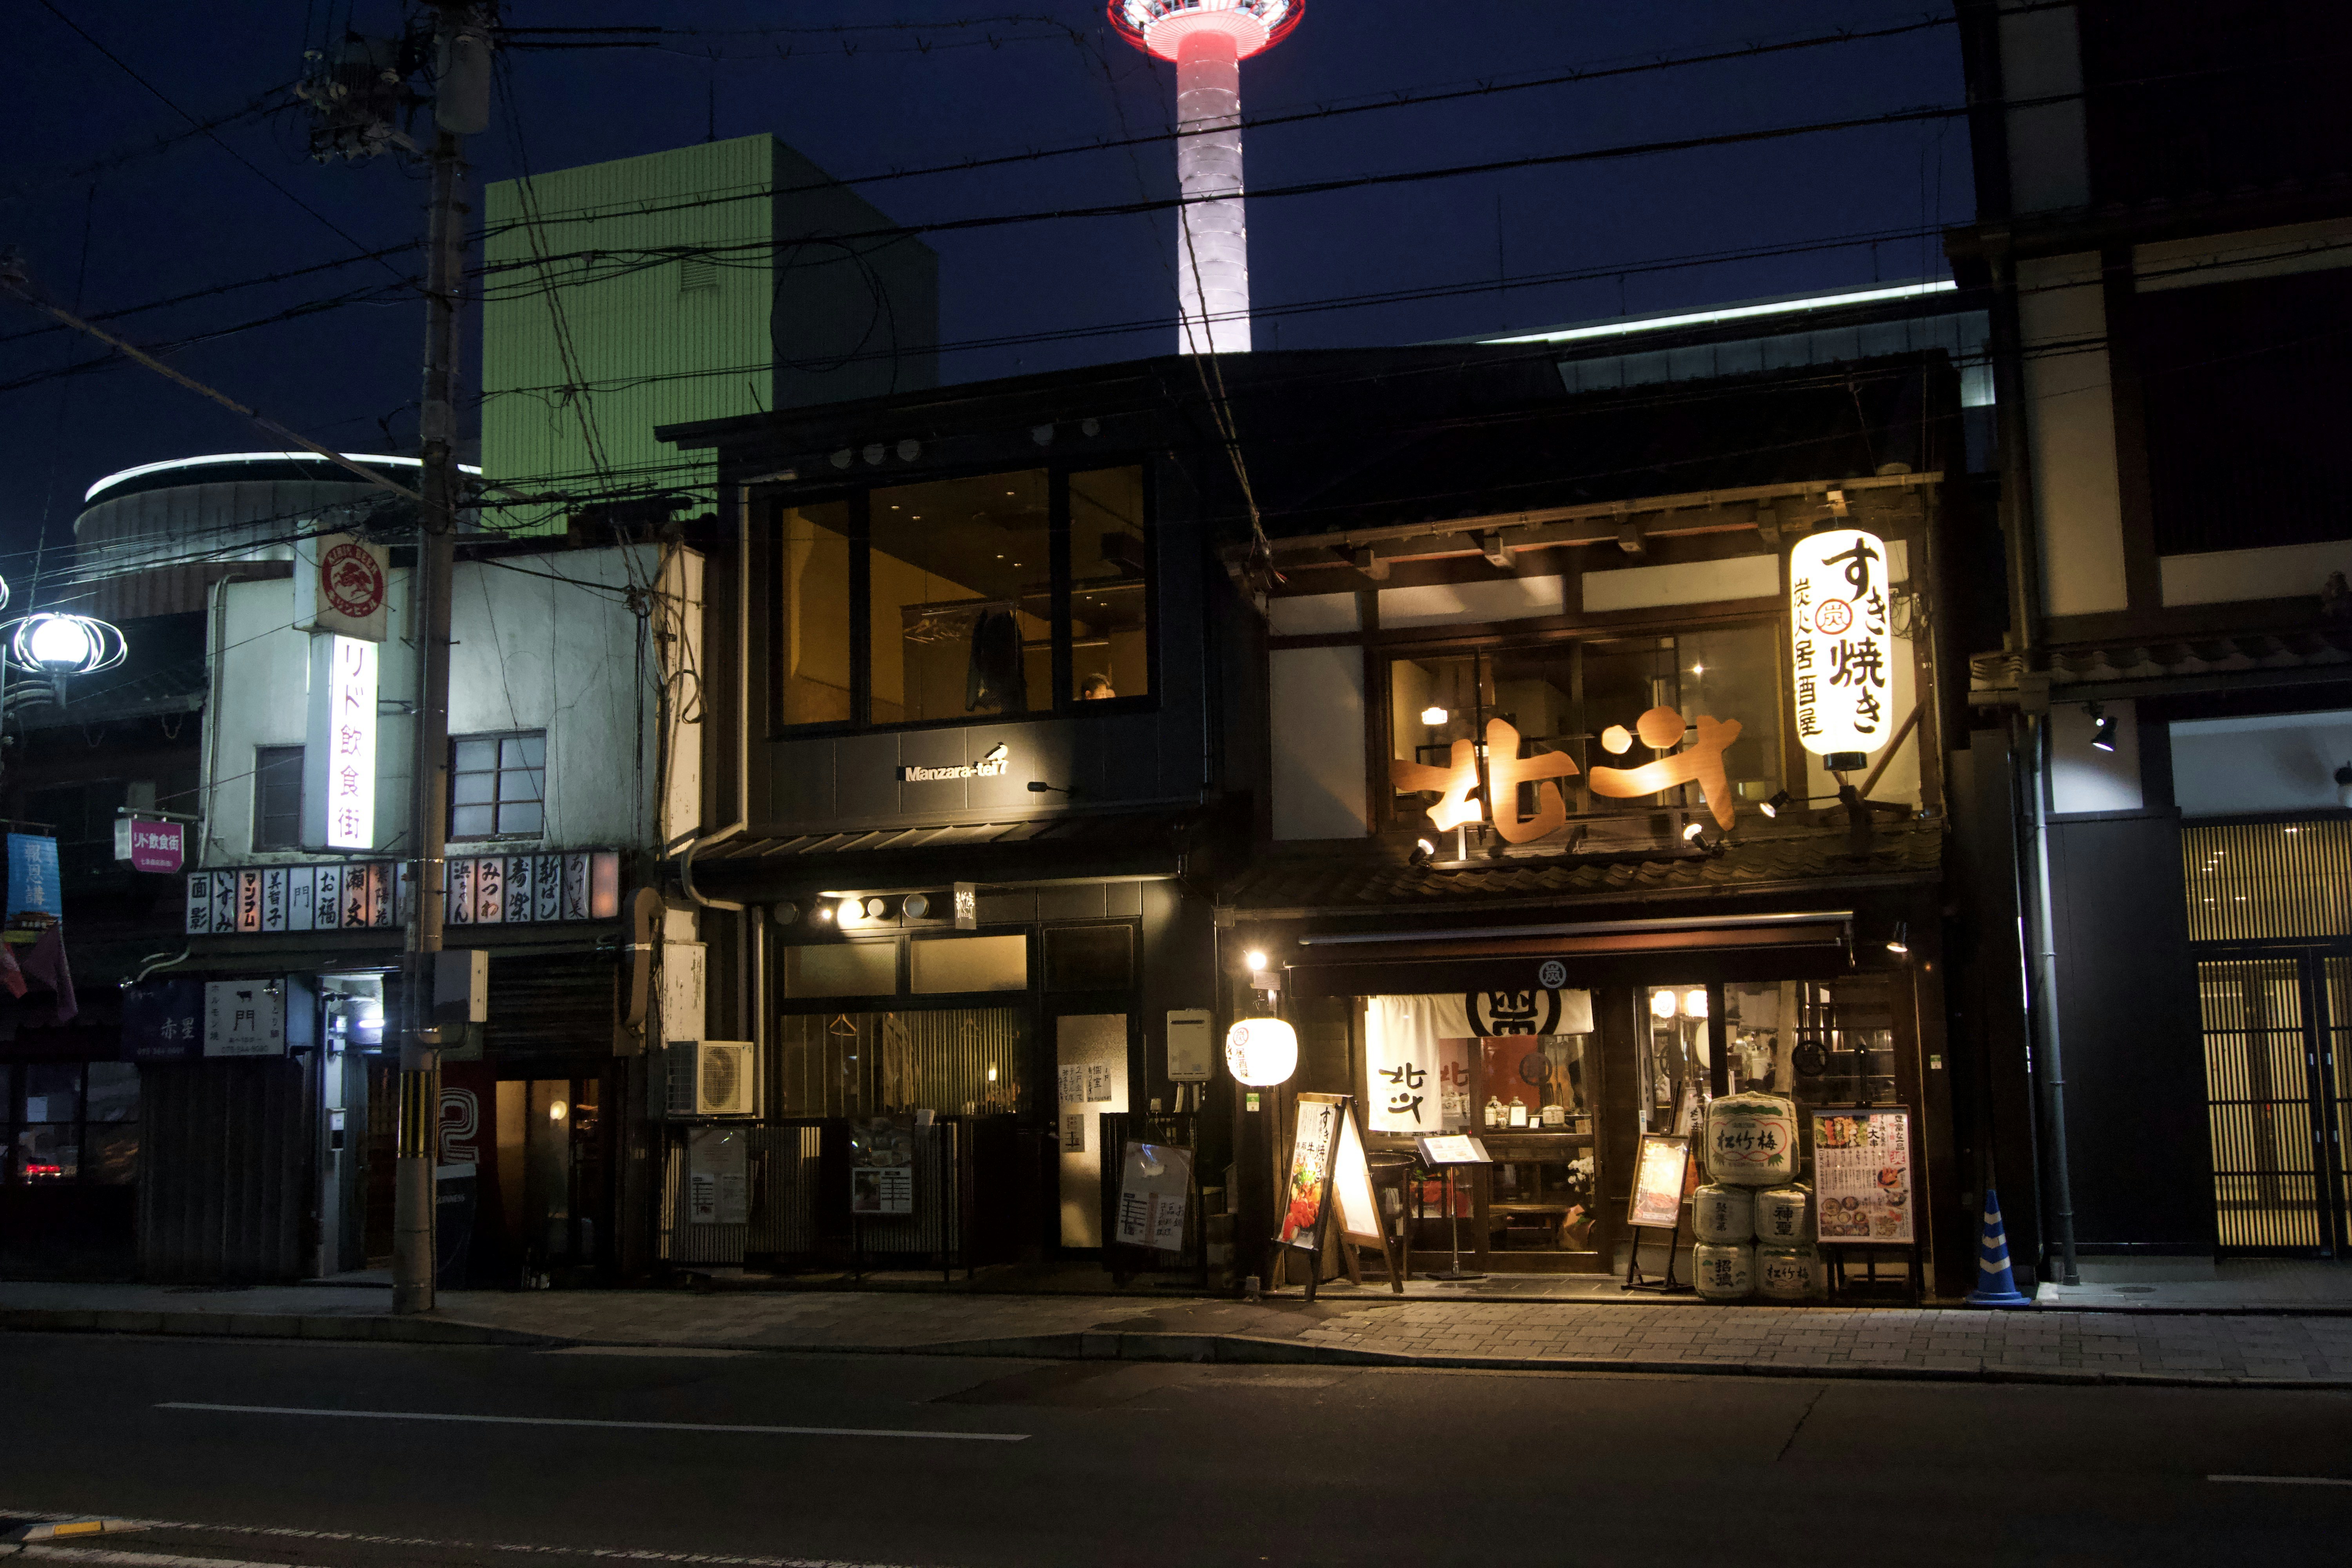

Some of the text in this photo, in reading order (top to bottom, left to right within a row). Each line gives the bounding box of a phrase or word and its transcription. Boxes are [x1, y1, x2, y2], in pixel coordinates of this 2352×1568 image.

[1821, 602, 1851, 630] 炭
[1821, 537, 1886, 733] すき焼き
[1793, 578, 1823, 737] 炭火居酒屋
[338, 644, 364, 839] リド飲食街
[134, 831, 180, 851] リド飲食街
[190, 876, 207, 930] 面影
[293, 885, 310, 909] 門
[318, 871, 337, 925] お福
[481, 862, 500, 918] みつわ
[161, 1017, 195, 1040] 赤星
[234, 1010, 255, 1031] 門
[1235, 1048, 1252, 1077] 居酒屋
[1314, 1106, 1331, 1182] すき焼き
[1717, 1129, 1777, 1151] 松竹梅
[1895, 1115, 1905, 1151] 豊富な一品
[1307, 1142, 1314, 1154] 牛
[1773, 1206, 1794, 1236] 神聖
[1767, 1264, 1809, 1279] 松竹梅
